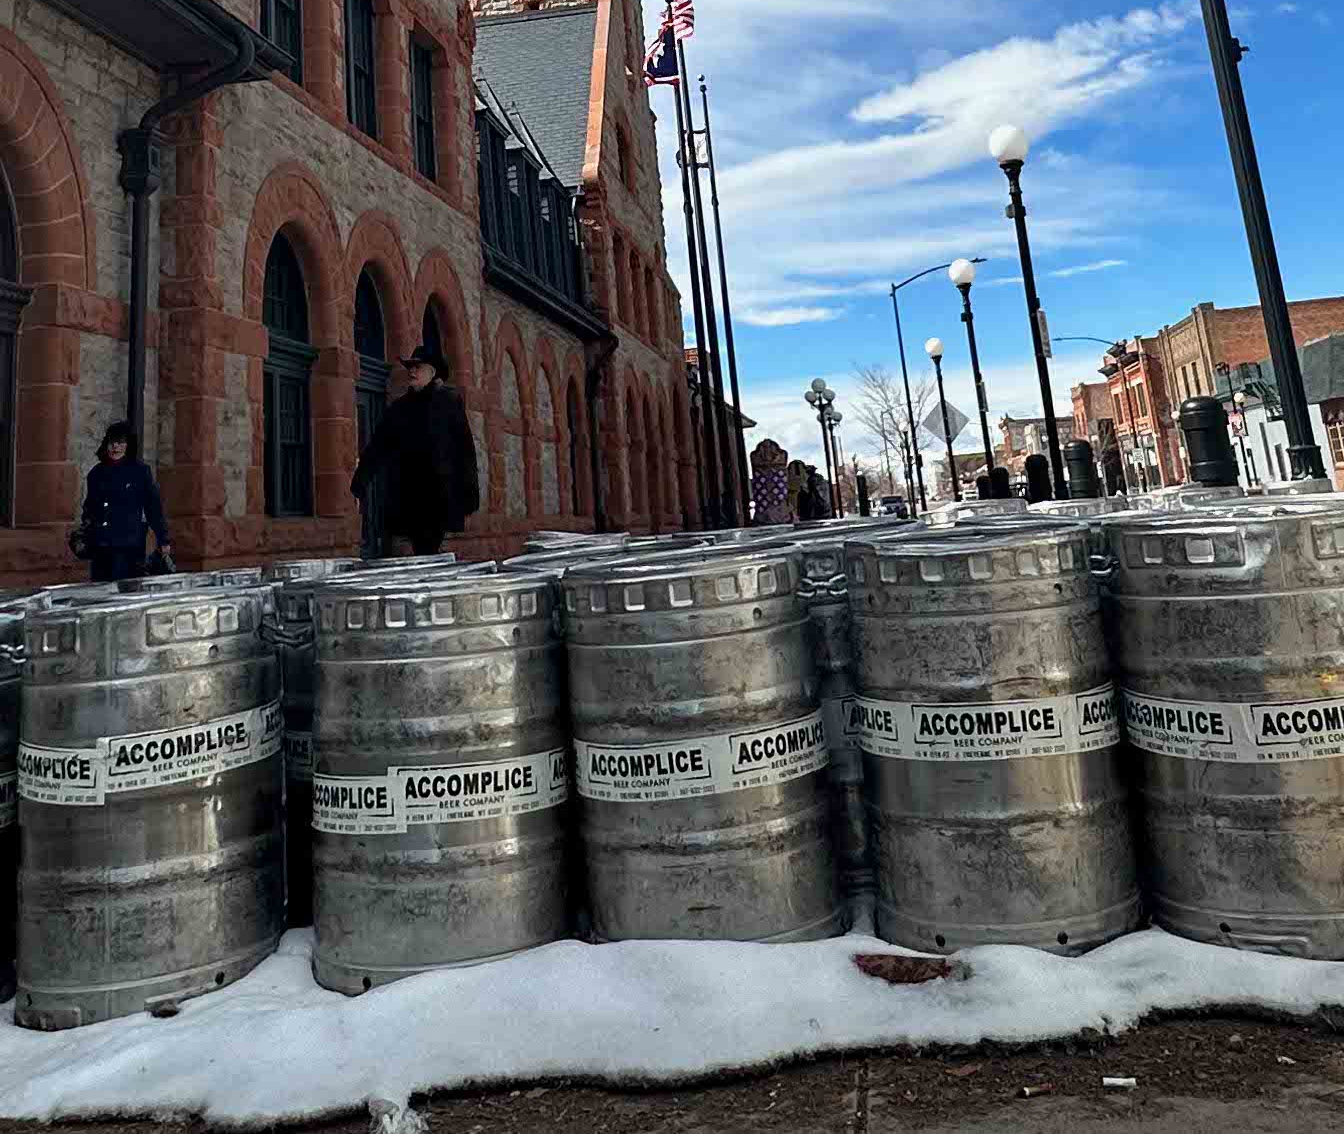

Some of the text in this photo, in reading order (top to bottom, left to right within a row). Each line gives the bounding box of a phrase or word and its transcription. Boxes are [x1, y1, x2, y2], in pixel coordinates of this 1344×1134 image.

[919, 708, 1055, 735] ACCOMPLICE
[116, 722, 246, 767] ACCOMPLICE
[978, 736, 1024, 747] COMPANY
[177, 753, 218, 769] COMPANY
[591, 749, 704, 778] ACCOMPLICE
[406, 766, 532, 800] ACCOMPLICE
[631, 778, 671, 789] COMPANY
[463, 795, 505, 808] COMPANY
